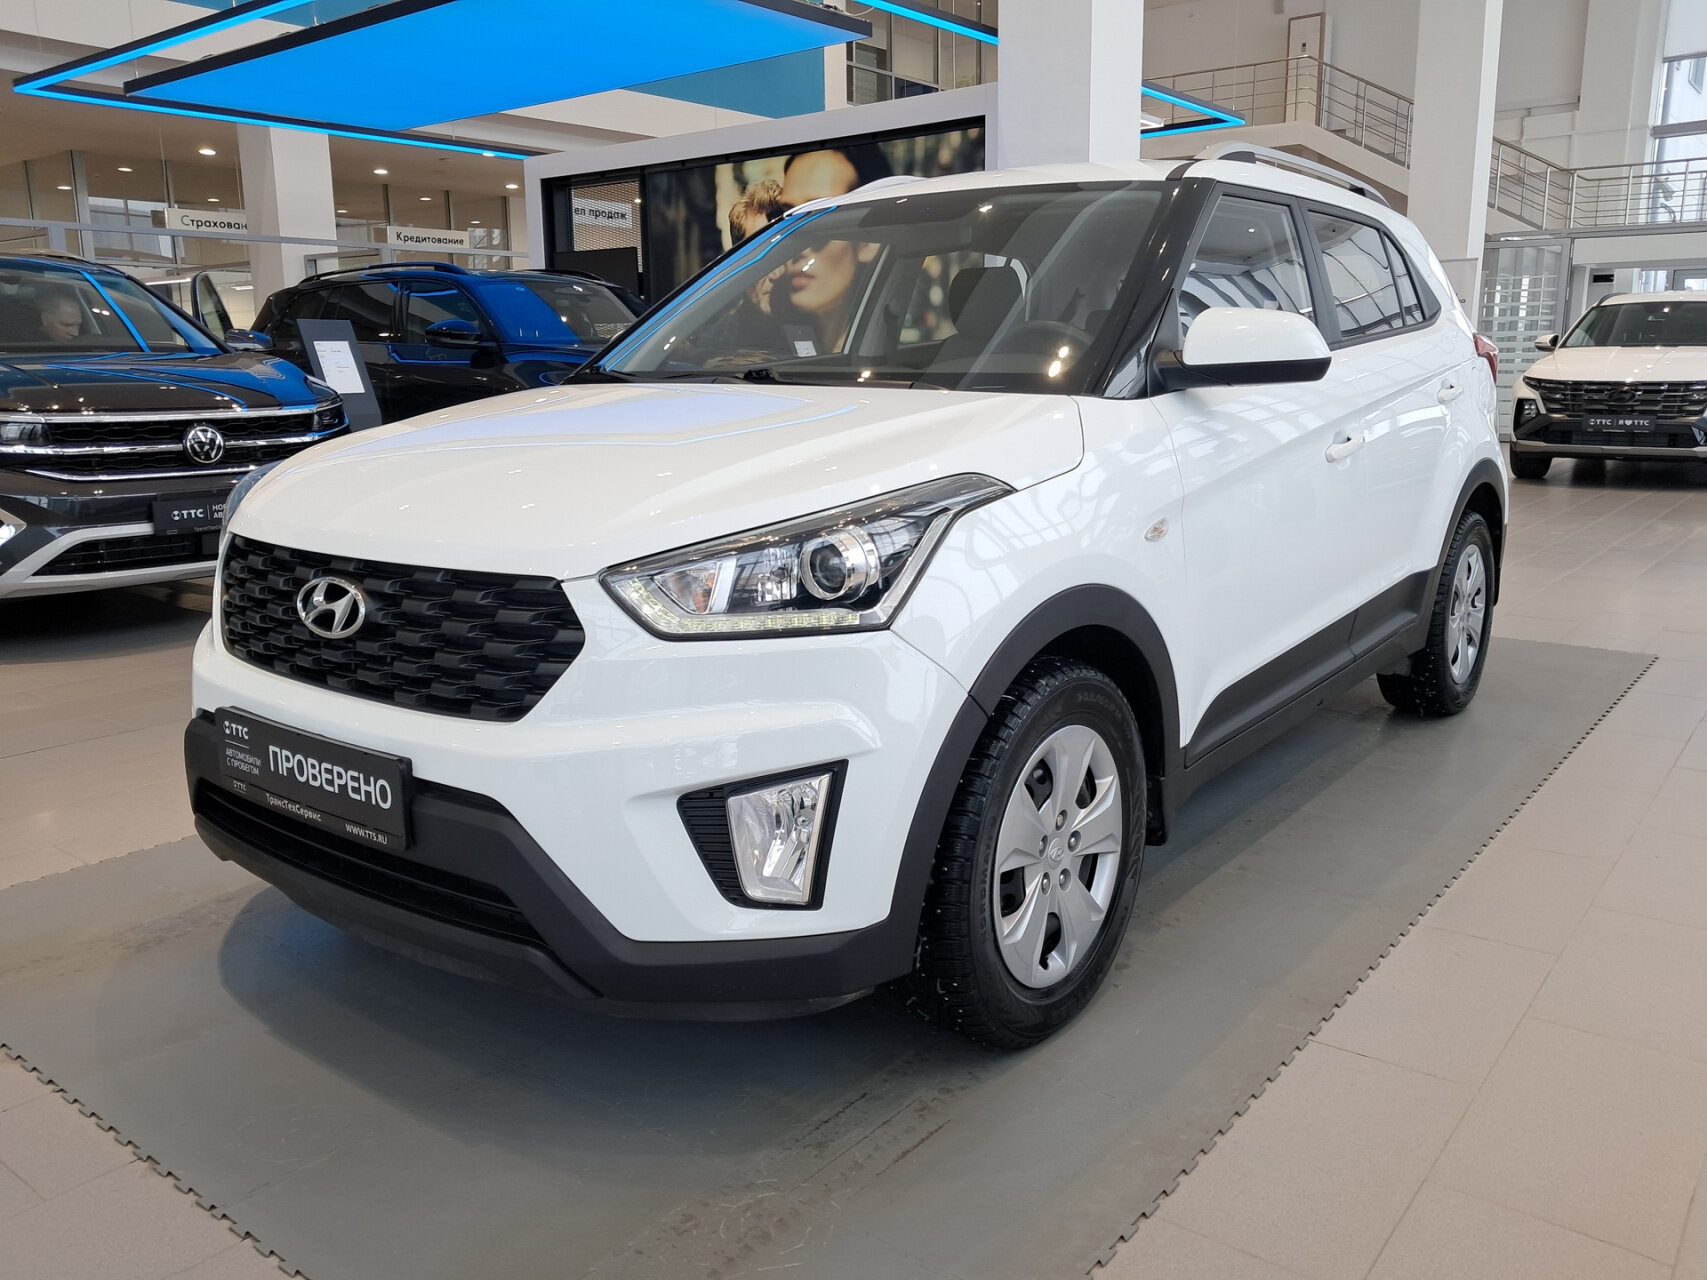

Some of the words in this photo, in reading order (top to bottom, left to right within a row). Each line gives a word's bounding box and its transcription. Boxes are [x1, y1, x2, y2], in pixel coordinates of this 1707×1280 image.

[180, 214, 248, 230] Страхован
[588, 207, 627, 220] продаж
[395, 231, 464, 246] Кредитование
[181, 508, 204, 519] ТТС
[230, 723, 249, 740] ТТС
[225, 748, 262, 767] АВТОМОБИЛИ
[268, 745, 392, 810] ПРОВЕРЕНО
[265, 792, 322, 822] ТрансТехСервис
[344, 823, 388, 845] WWW.TTS.RU
